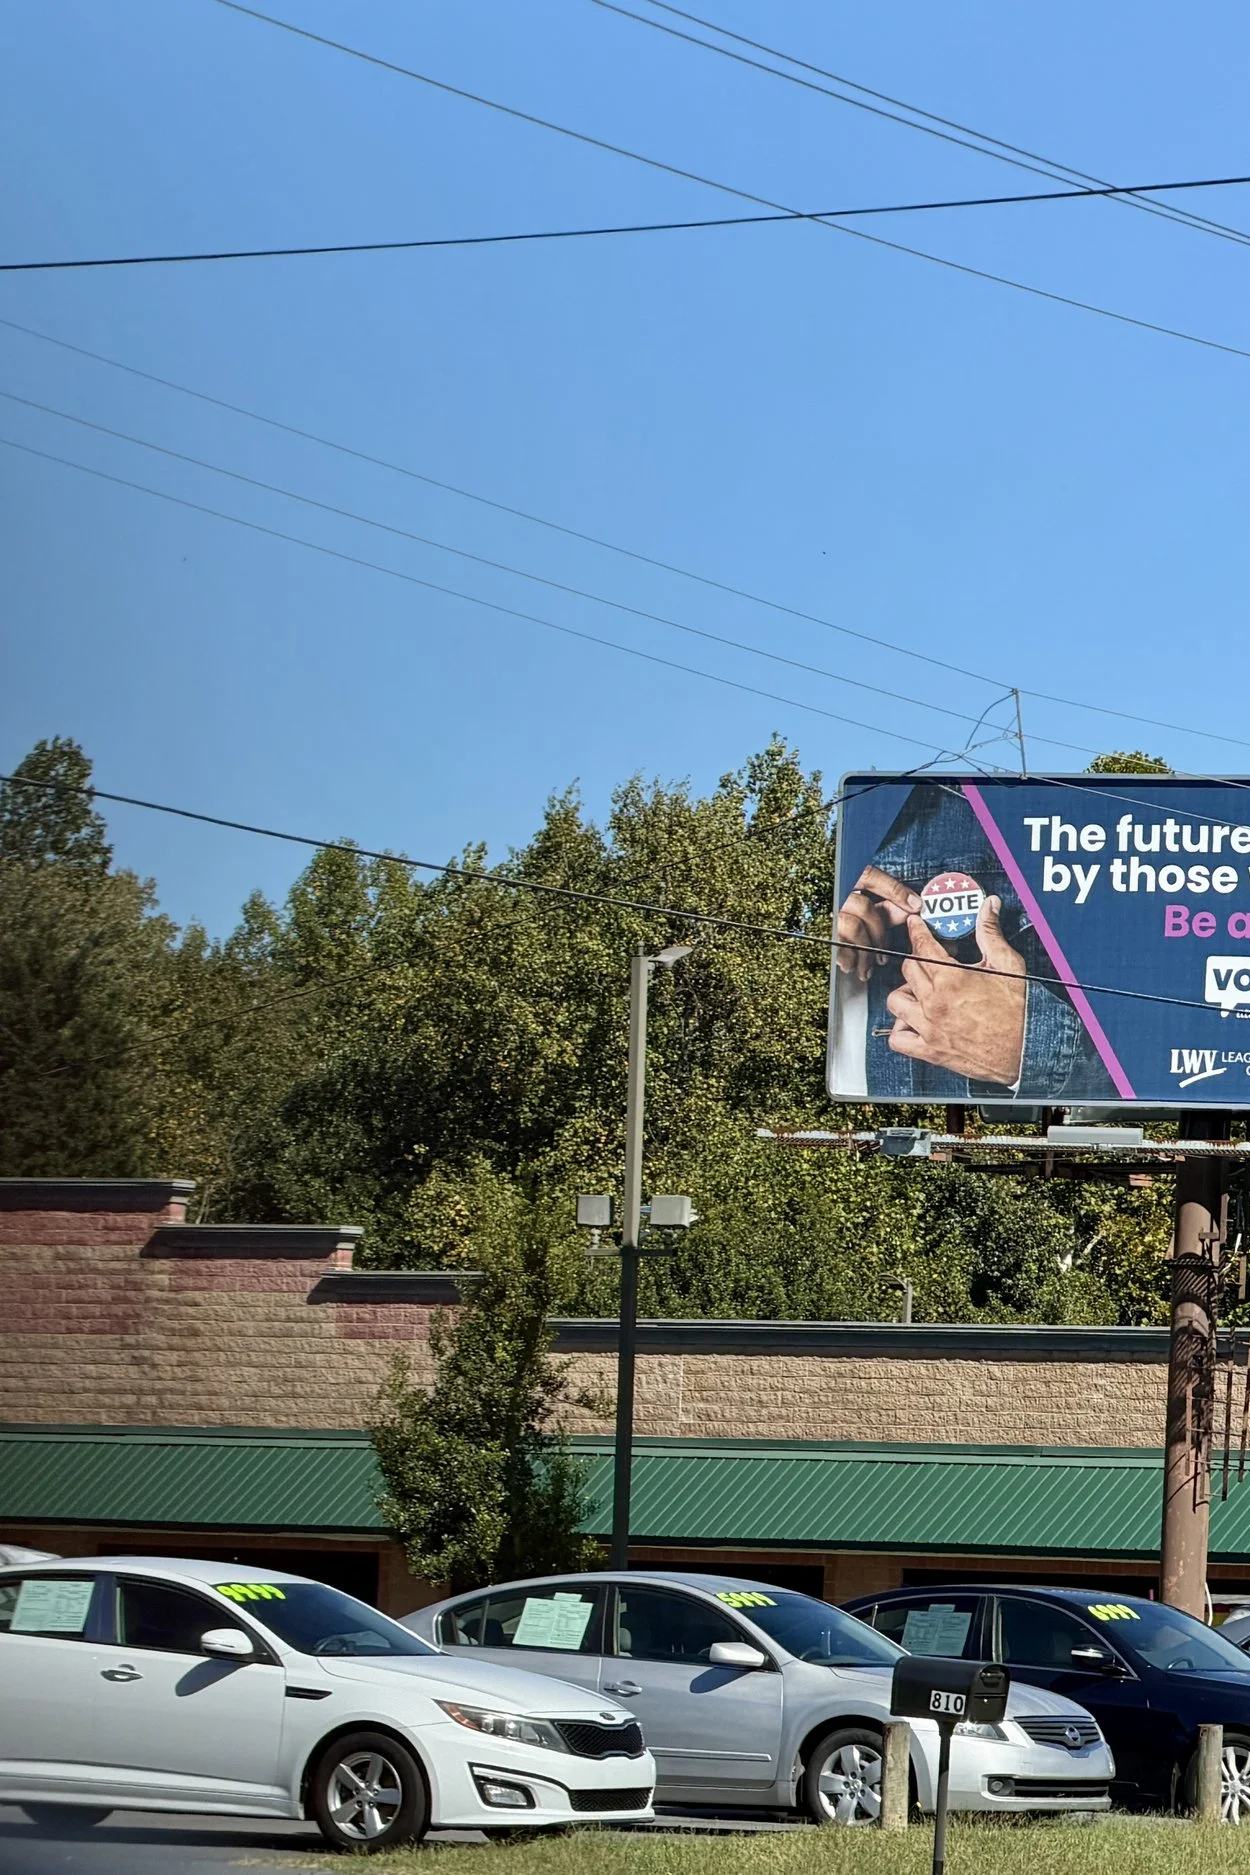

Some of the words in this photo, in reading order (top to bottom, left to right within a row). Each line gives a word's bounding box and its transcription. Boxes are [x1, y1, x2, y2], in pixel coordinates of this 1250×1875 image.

[1023, 815, 1106, 852] The
[1042, 856, 1101, 904] by
[1110, 856, 1239, 894] those
[924, 894, 979, 915] VOTE
[1164, 904, 1217, 939] Be
[1170, 1049, 1219, 1074] LWV
[216, 1584, 286, 1602] 9999
[716, 1592, 778, 1608] 5999
[931, 1692, 964, 1713] 810
